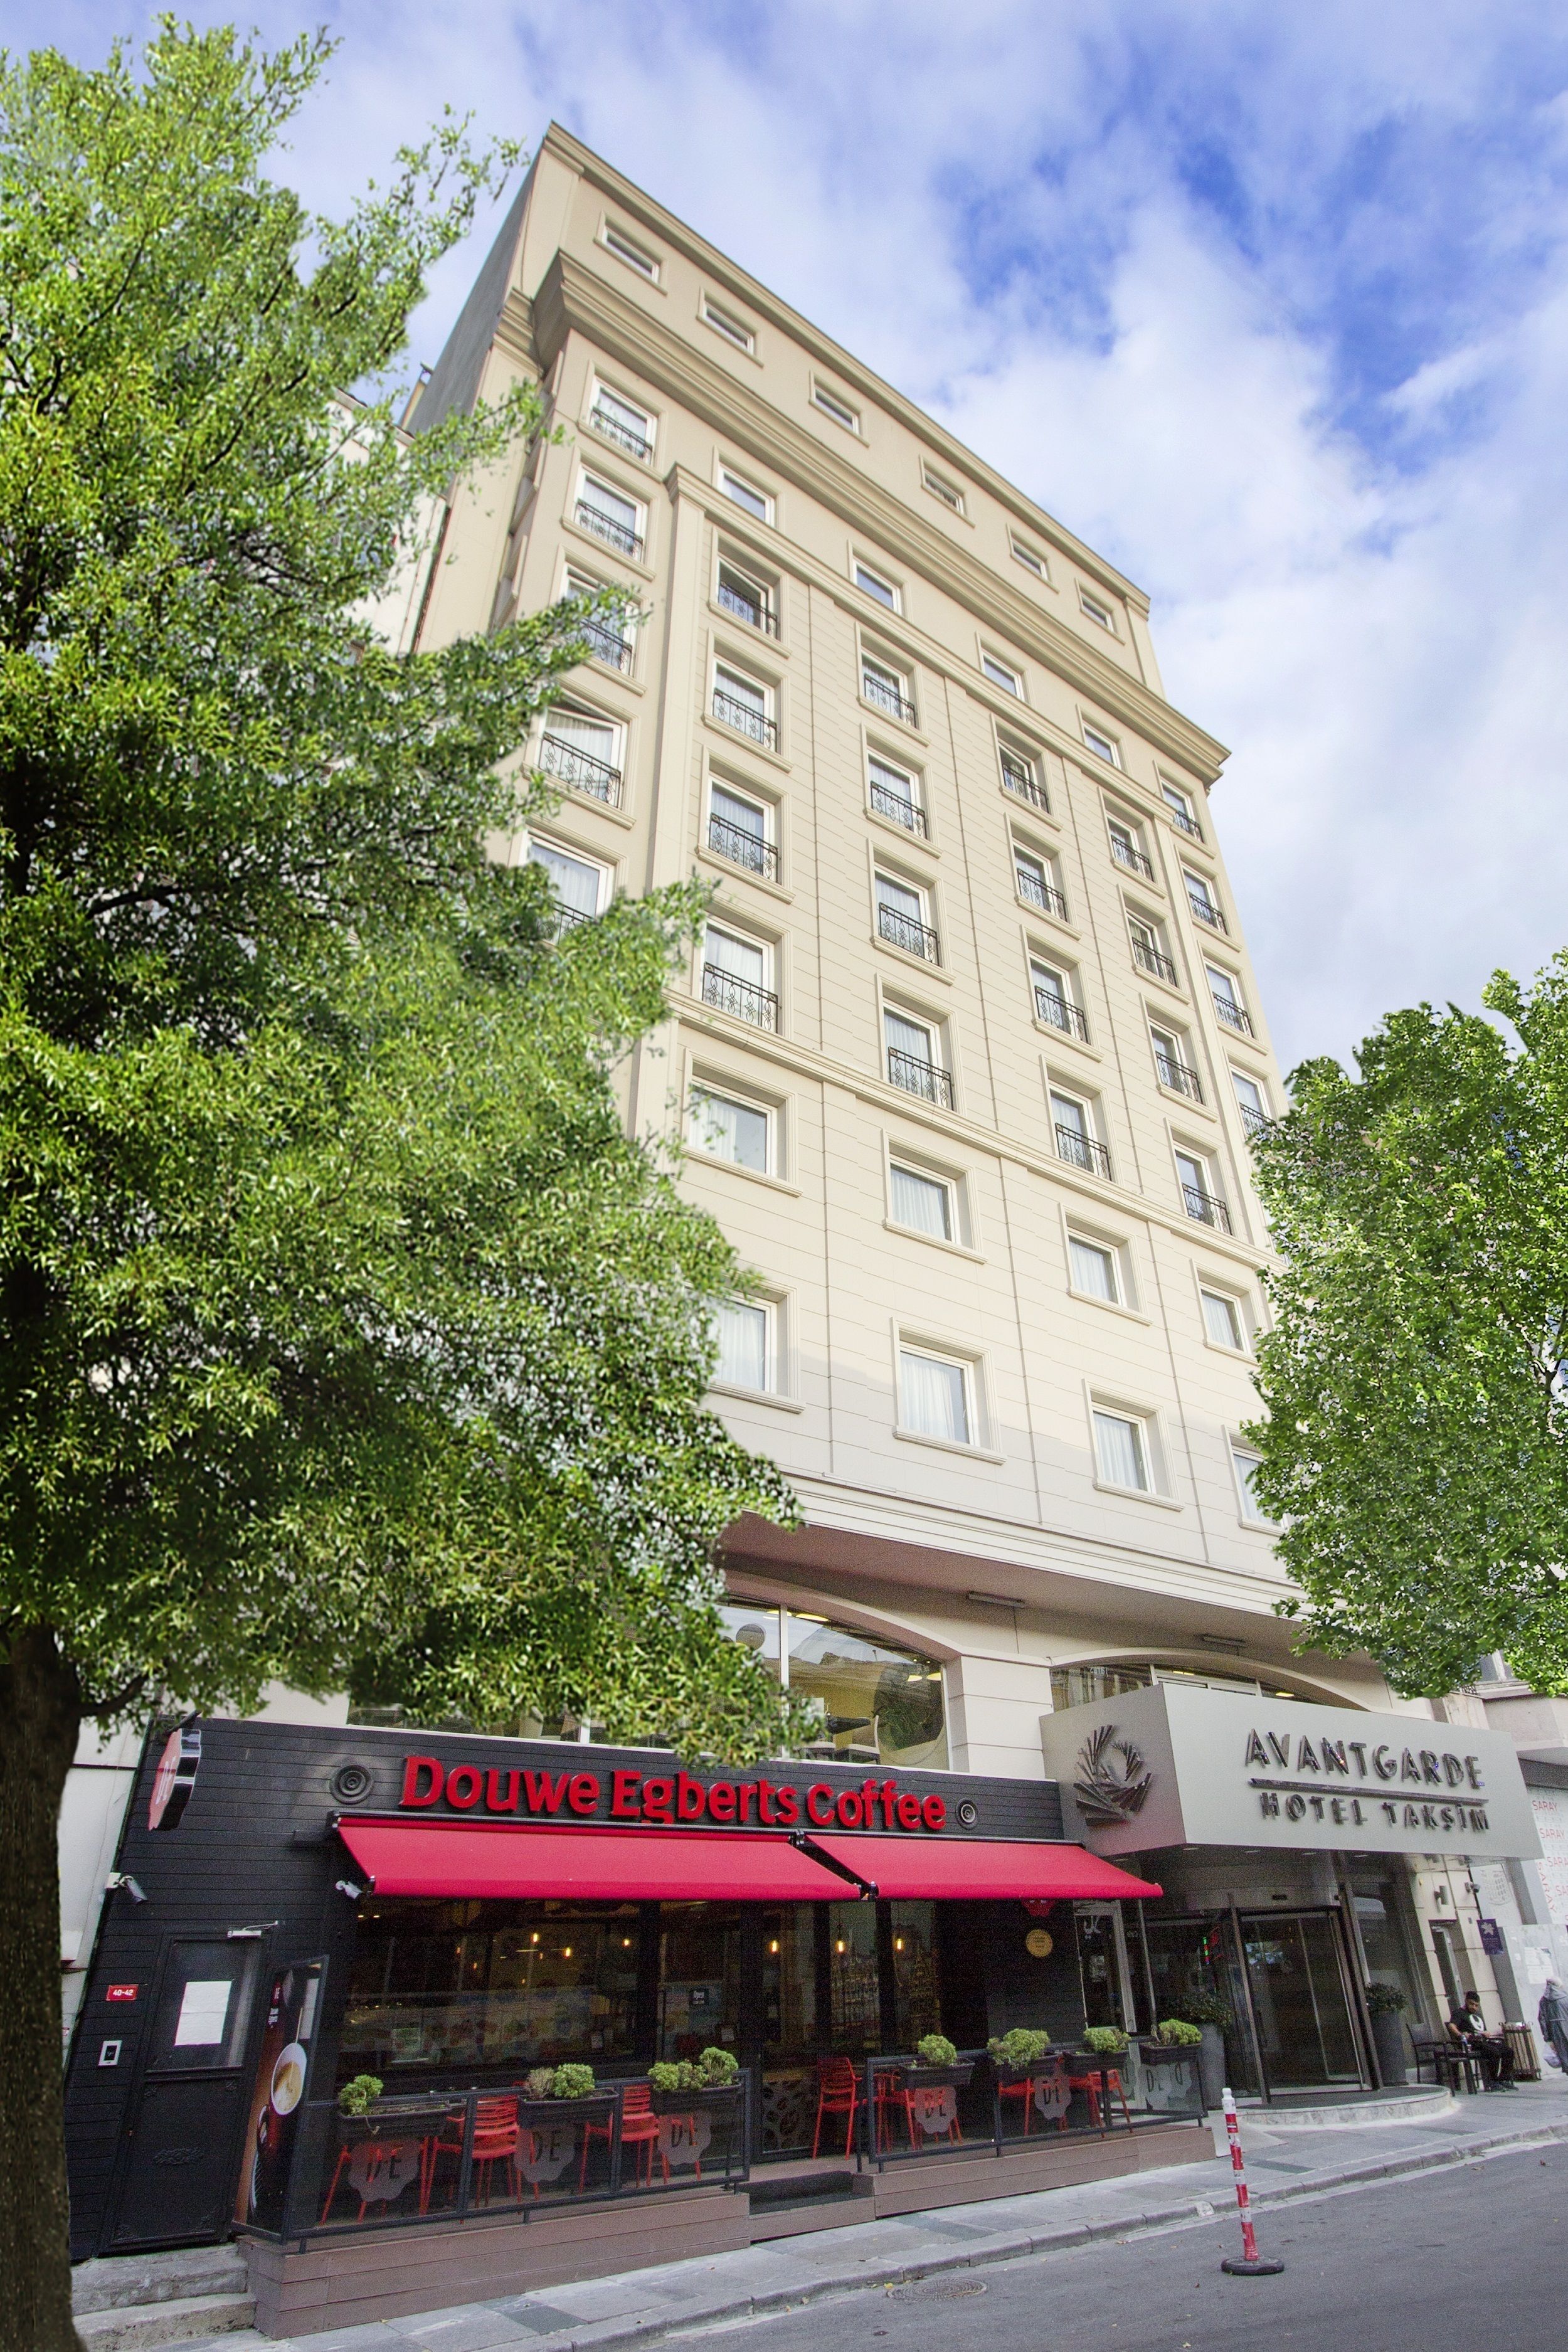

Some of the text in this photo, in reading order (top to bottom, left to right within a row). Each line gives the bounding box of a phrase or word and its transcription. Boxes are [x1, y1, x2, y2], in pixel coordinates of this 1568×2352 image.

[1246, 1728, 1485, 1789] AVANTGARDE
[399, 1756, 946, 1830] Douwe Egberts Coffee
[1261, 1792, 1368, 1826] HOTEL
[1532, 1800, 1557, 1812] SARAY
[1539, 1828, 1565, 1840] SARAY
